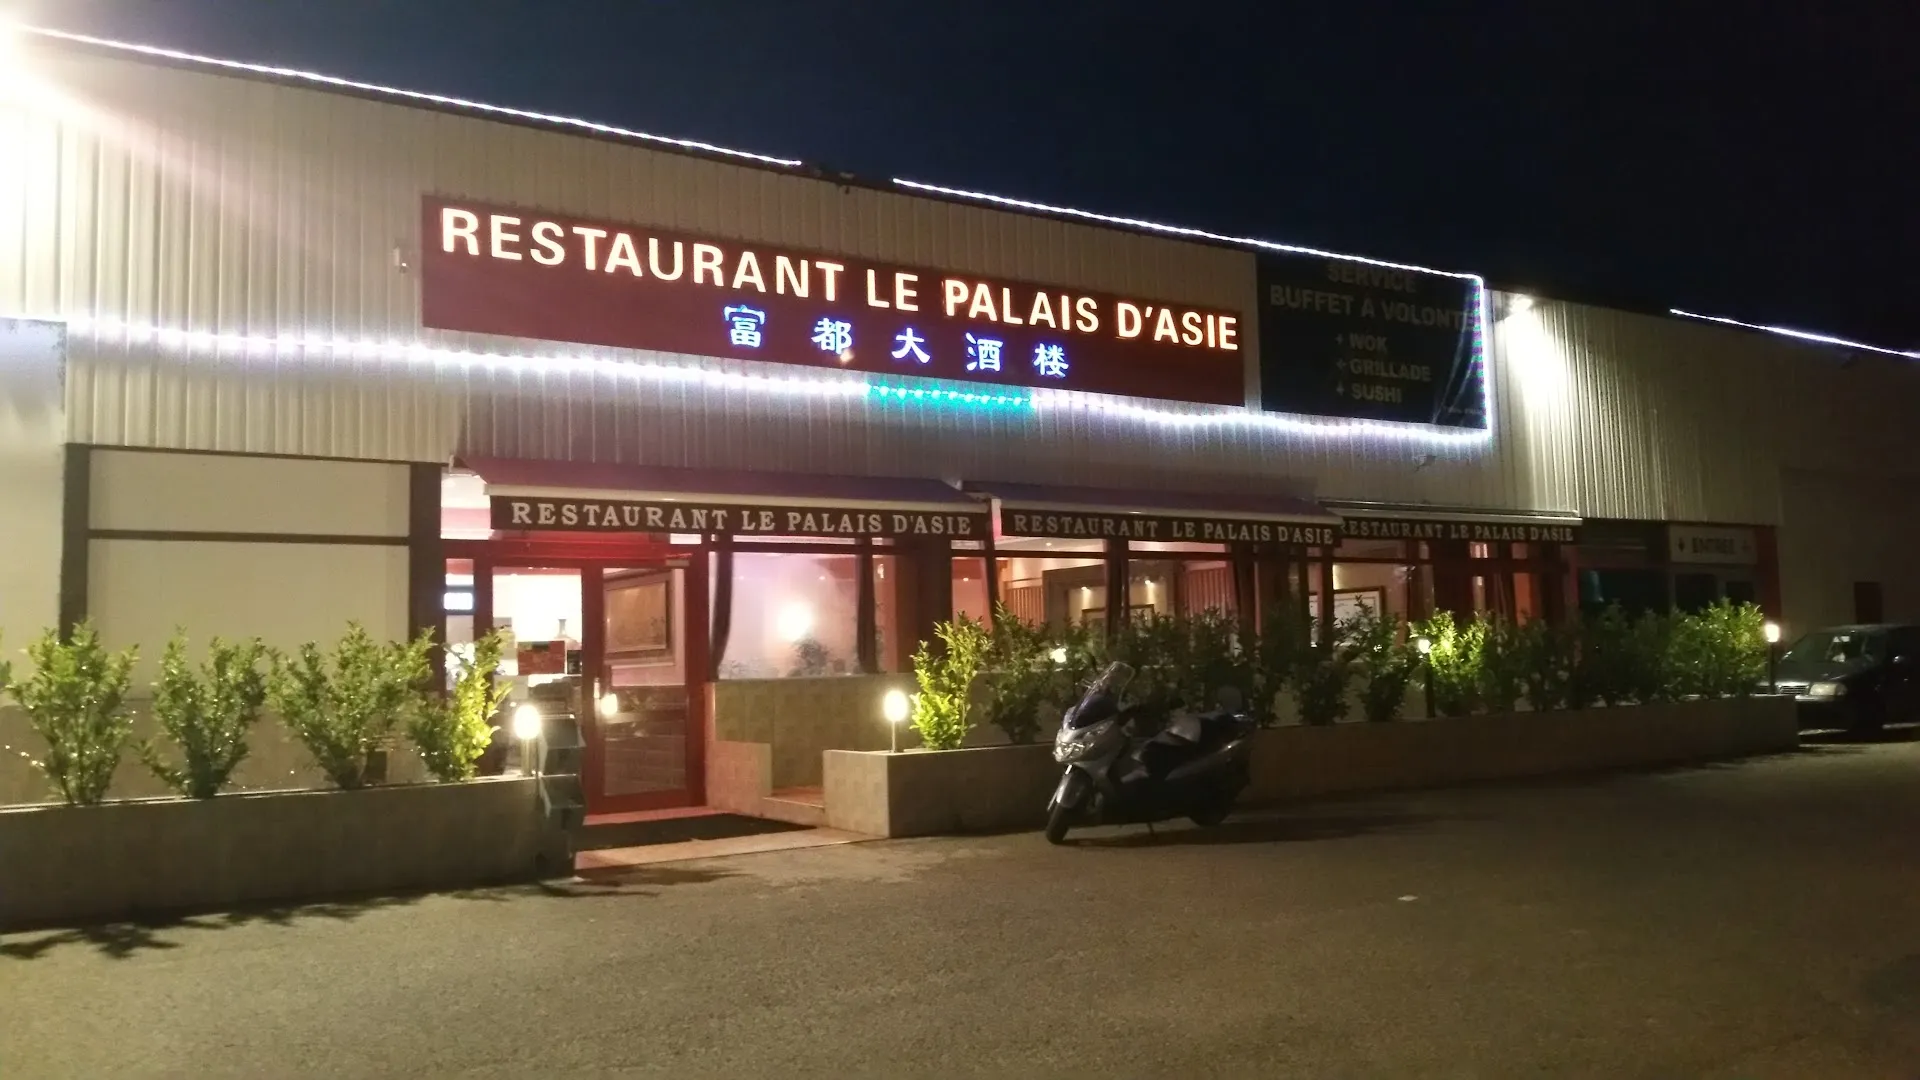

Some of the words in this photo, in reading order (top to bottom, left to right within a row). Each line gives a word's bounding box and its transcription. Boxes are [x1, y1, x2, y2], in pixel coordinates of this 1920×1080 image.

[440, 206, 845, 302] RESTAURANT
[866, 268, 919, 312] LE
[943, 278, 1100, 333] PALAIS
[1117, 302, 1239, 351] D'ASIE
[1270, 284, 1353, 315] BUFFET
[723, 304, 1069, 378] 富都大酒楼
[1349, 332, 1387, 354] WOK
[1349, 358, 1431, 382] GRILLADE
[1351, 382, 1402, 405] SUSHI
[511, 501, 728, 531] RESTAURANT
[741, 509, 776, 532] LE
[787, 511, 883, 534] PALAIS
[893, 514, 972, 536] D'ASIE
[1014, 513, 1158, 538] RESTAURANT
[1172, 520, 1196, 538] LE
[1204, 521, 1271, 541] PALAIS
[1278, 526, 1334, 545] D'ASIE
[1450, 524, 1470, 540] LE
[1475, 525, 1526, 541] PALAIS
[1530, 527, 1574, 543] D'ASIE
